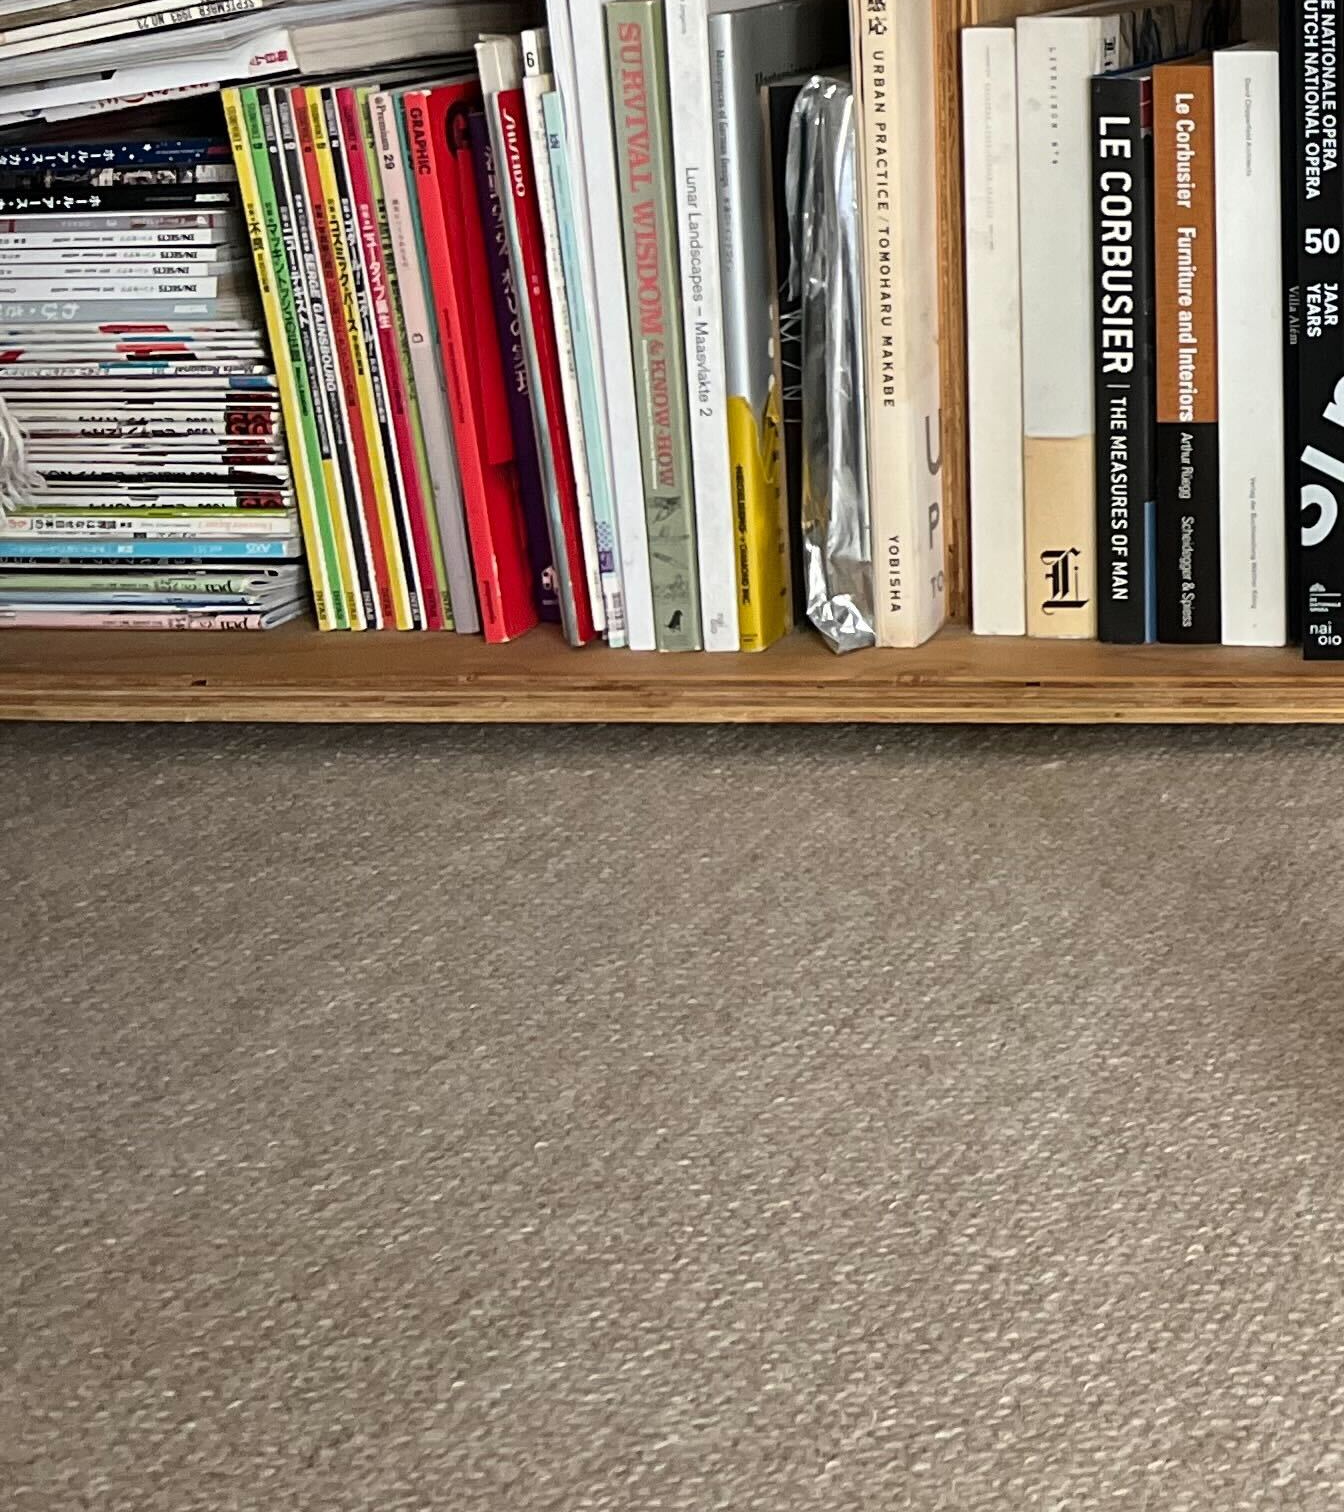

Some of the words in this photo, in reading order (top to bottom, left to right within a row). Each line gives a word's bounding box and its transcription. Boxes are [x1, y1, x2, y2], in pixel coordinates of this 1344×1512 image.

[872, 50, 887, 113] URBAN
[1304, 51, 1320, 138] NATIONAL
[1321, 14, 1337, 114] NATIONALE
[375, 102, 392, 152] Premium
[1174, 93, 1195, 115] Le
[383, 155, 396, 170] 29
[409, 106, 432, 176] GRAPHIC
[502, 106, 526, 198] SHISEIDO
[875, 123, 890, 211] PRACTICE
[1099, 116, 1132, 159] LE
[1175, 119, 1197, 209] Corbusier
[1322, 117, 1337, 171] OPERA
[1306, 143, 1321, 199] OPERA
[1100, 171, 1134, 374] CORBUSIER
[1177, 226, 1198, 307] Furniture
[1304, 227, 1341, 255] 50
[304, 253, 322, 300] SERGE
[876, 227, 893, 329] TOMOHARU
[1323, 283, 1339, 325] JAAR
[1178, 312, 1198, 344] and
[1306, 283, 1322, 337] YEARS
[311, 302, 338, 393] GAINSBOURG
[880, 335, 896, 408] MAKABE
[1110, 396, 1128, 430] THE
[1178, 348, 1199, 422] Interiors
[1110, 435, 1129, 529] MEASURES
[888, 534, 903, 614] YOBISHA
[1111, 533, 1129, 557] OF
[1111, 562, 1130, 601] MAN
